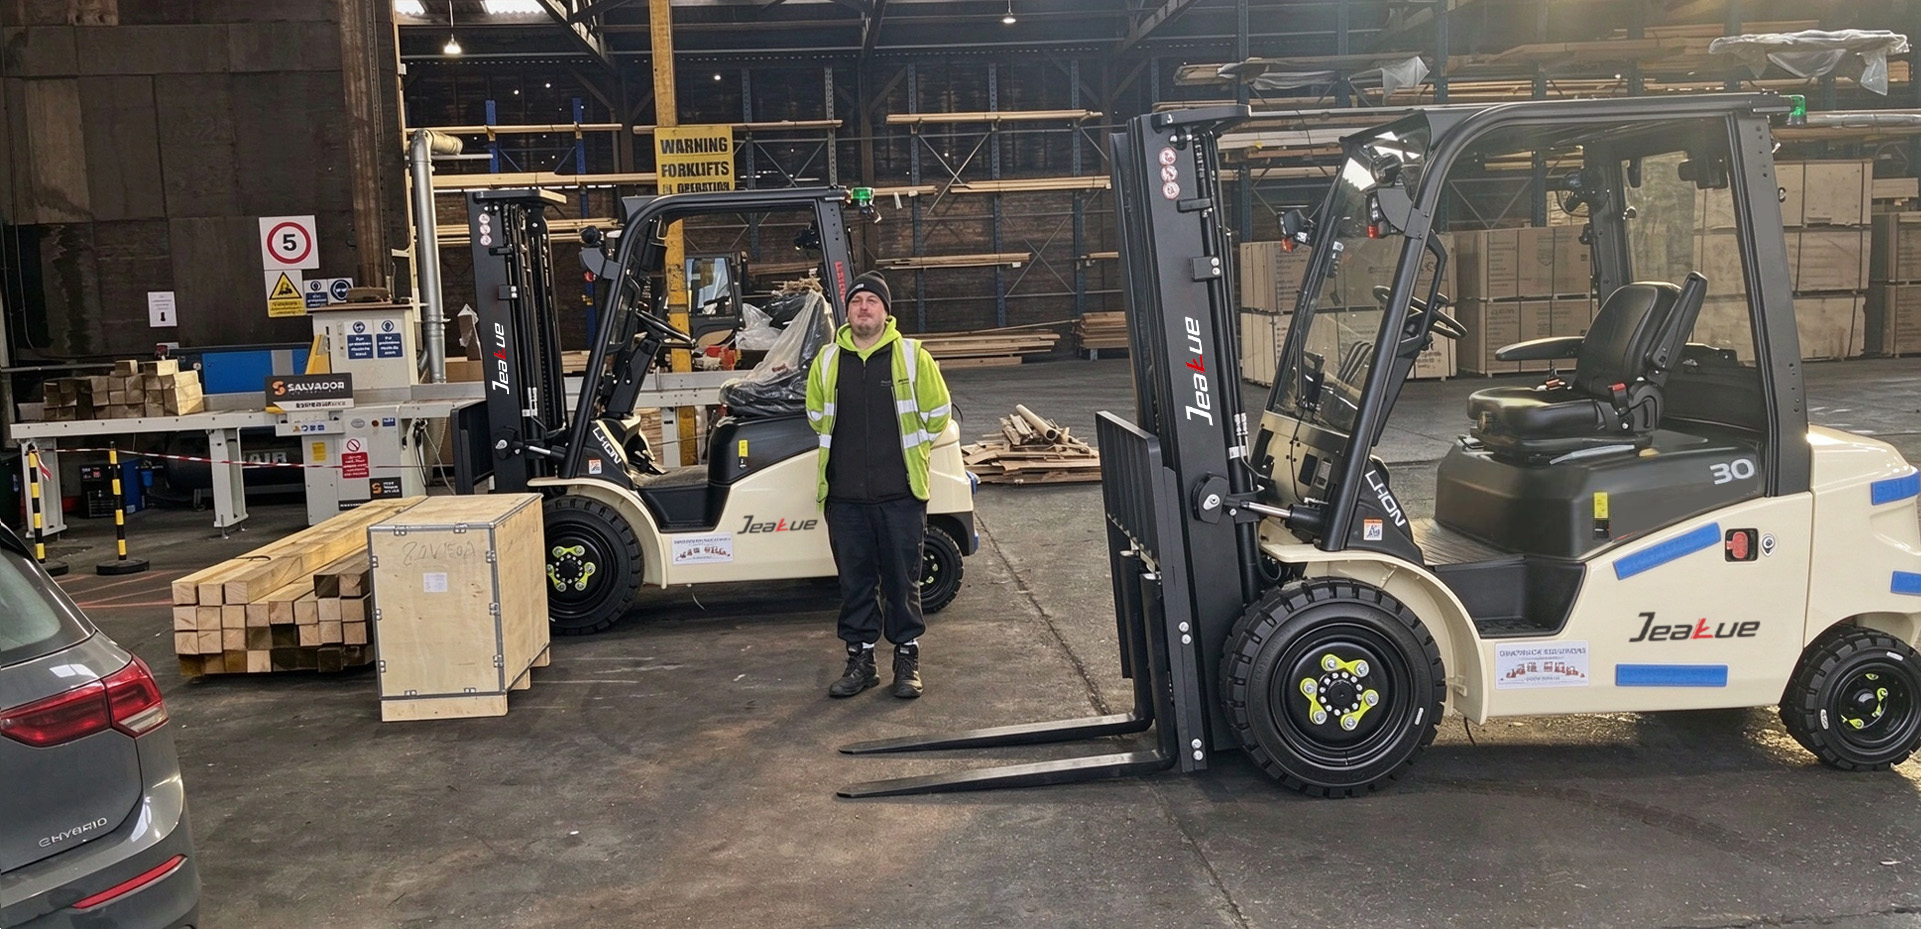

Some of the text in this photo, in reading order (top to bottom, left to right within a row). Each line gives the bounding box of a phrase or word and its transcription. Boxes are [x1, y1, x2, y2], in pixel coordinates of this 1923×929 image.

[660, 137, 728, 154] WARNING
[660, 161, 730, 178] FORKLIFTS
[283, 233, 297, 251] 5
[287, 381, 345, 392] SALVADOR
[1709, 459, 1755, 485] 30
